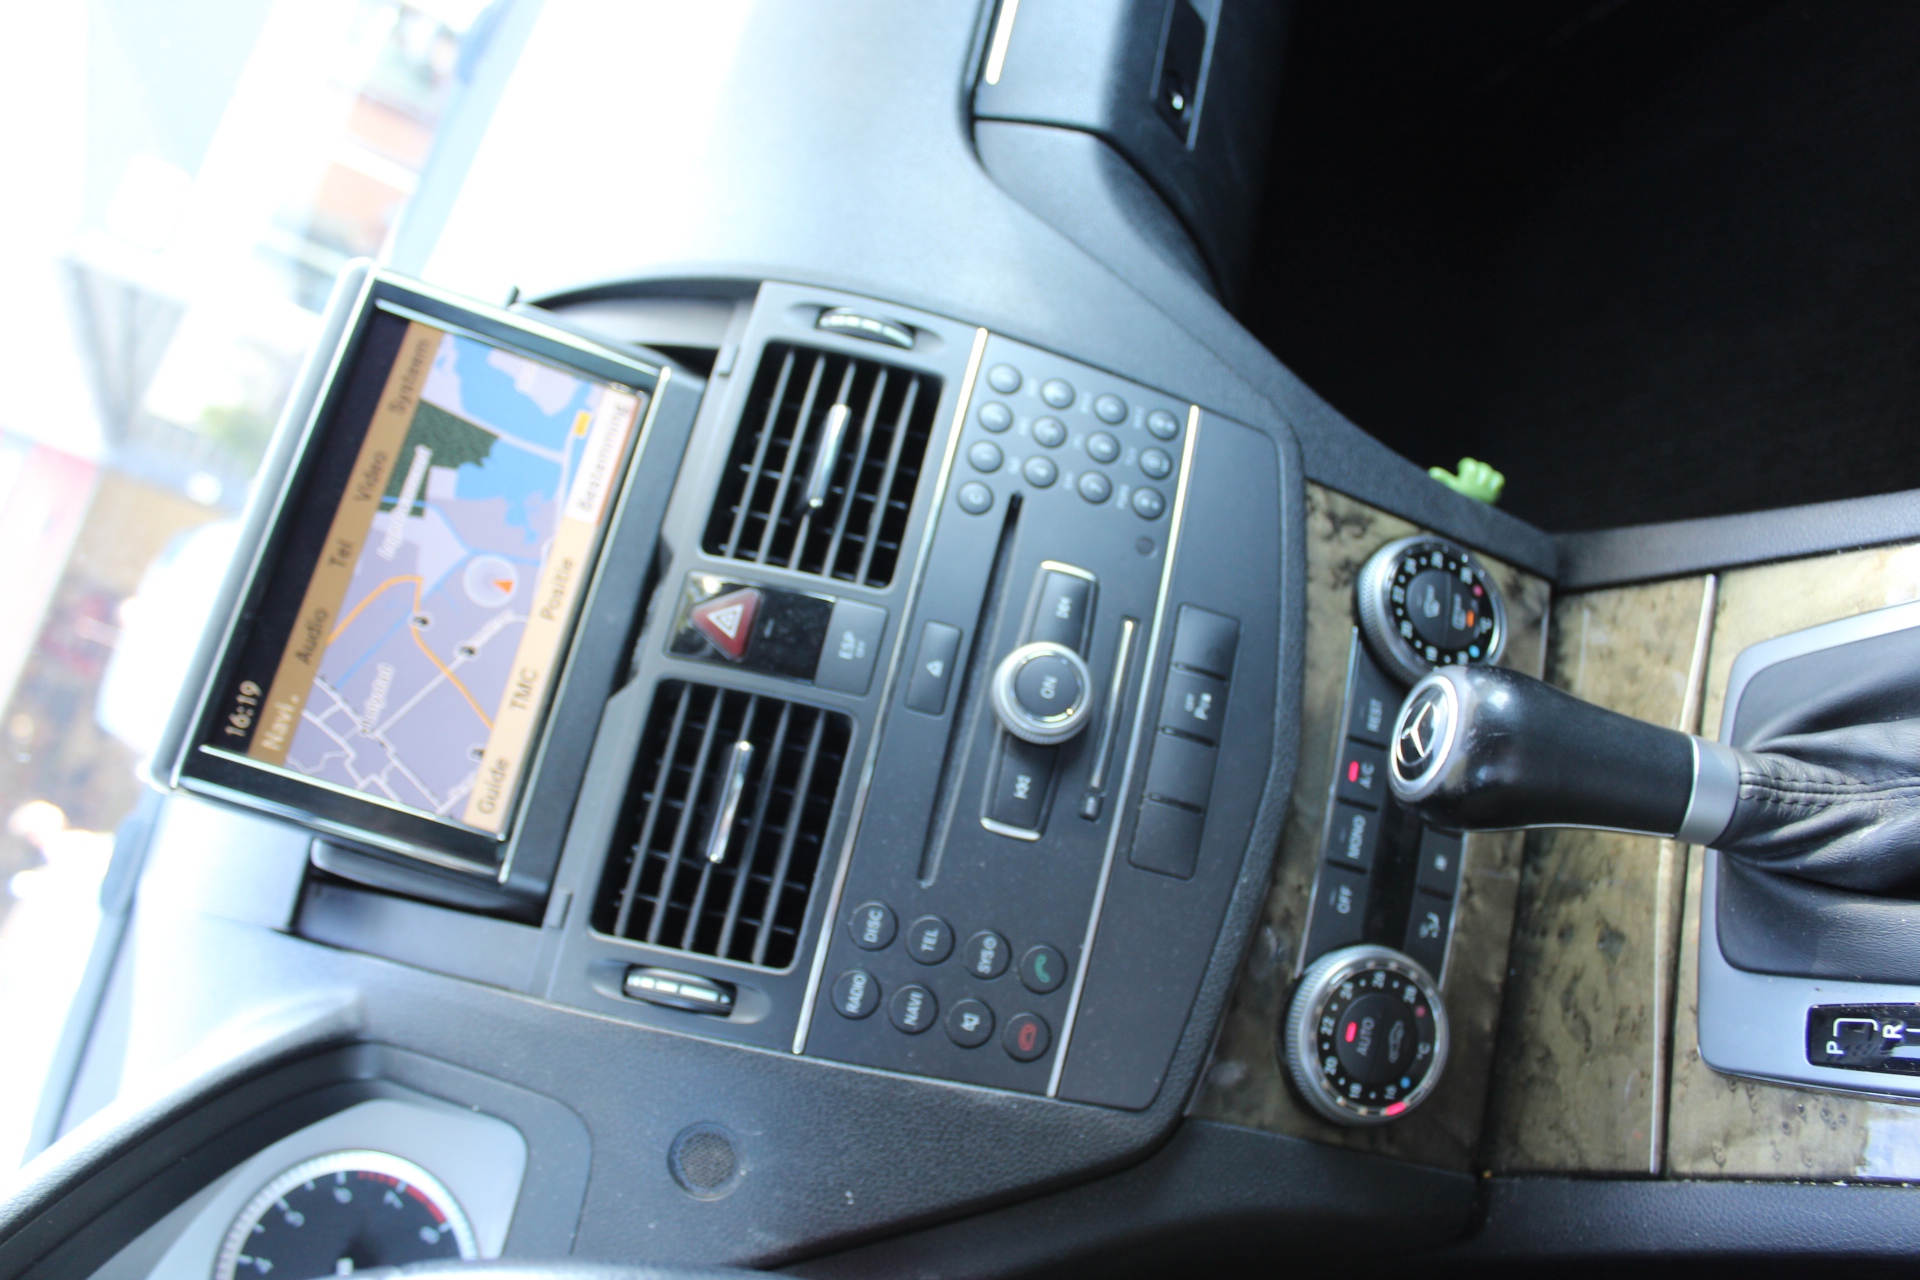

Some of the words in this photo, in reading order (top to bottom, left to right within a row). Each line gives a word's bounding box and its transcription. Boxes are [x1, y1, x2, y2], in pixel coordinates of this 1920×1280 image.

[388, 338, 431, 416] Systeem
[577, 402, 632, 512] Bestemming
[355, 451, 387, 502] Video
[328, 539, 353, 568] Tel
[540, 556, 574, 622] Positie
[295, 607, 328, 665] Audio
[838, 630, 857, 660] ESP
[508, 666, 540, 712] TMC
[1040, 675, 1058, 699] ON
[224, 680, 262, 737] 16:19
[1367, 698, 1384, 733] REST
[477, 757, 510, 815] Guide
[1347, 814, 1366, 860] MONO
[1336, 885, 1353, 914] OFF
[863, 908, 884, 943] DISC
[921, 928, 939, 952] TEL
[846, 973, 868, 1014] RADIO
[1340, 981, 1354, 999] 24
[904, 991, 923, 1026] NAVI
[1320, 1016, 1336, 1036] 22
[1356, 1016, 1375, 1057] AUTO
[1825, 1040, 1846, 1055] P
[1882, 1023, 1904, 1039] R
[1323, 1056, 1338, 1076] 20
